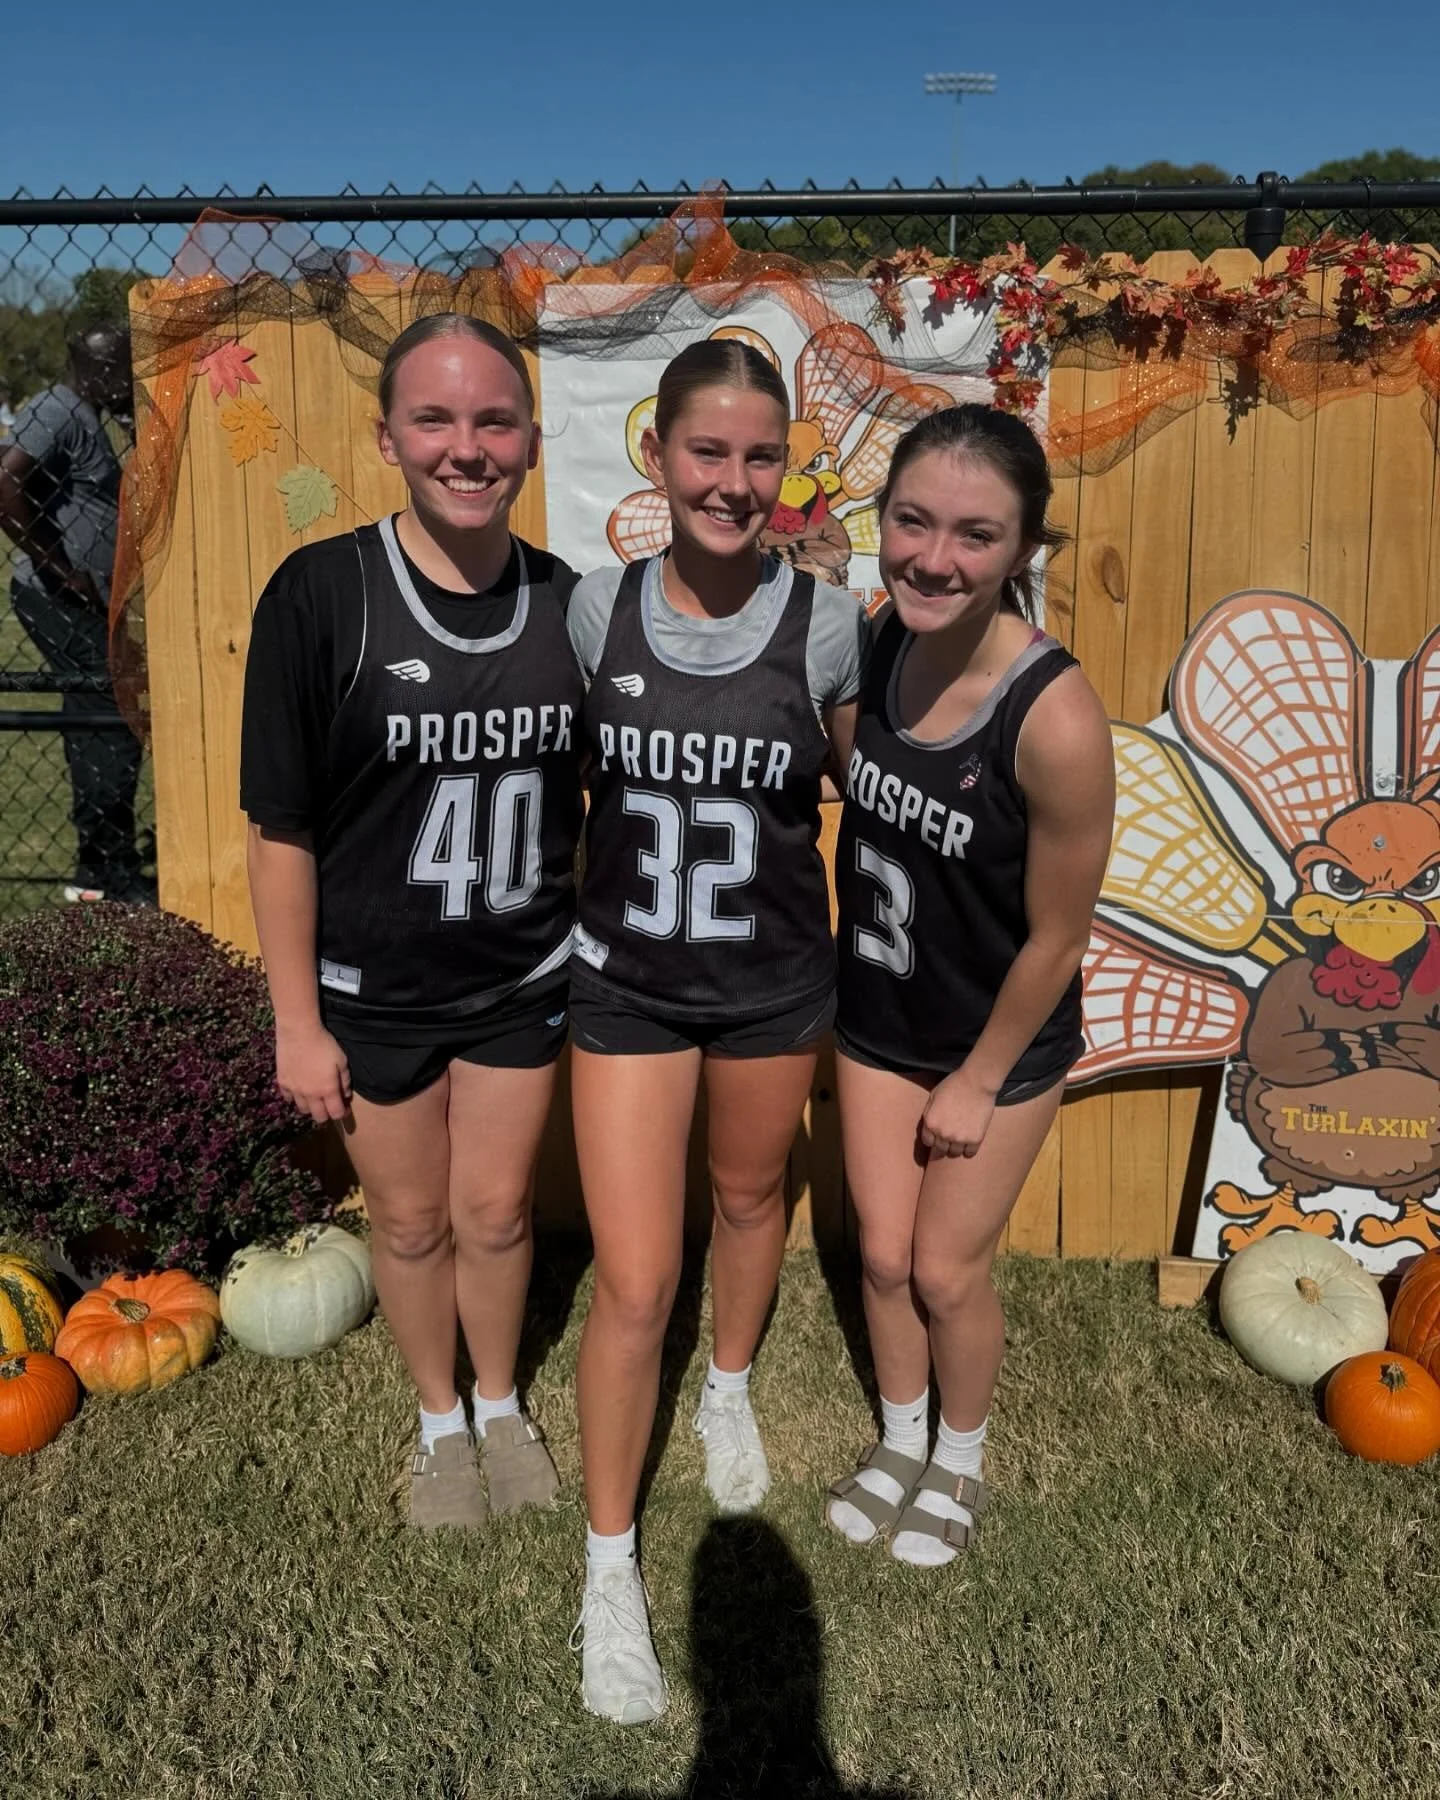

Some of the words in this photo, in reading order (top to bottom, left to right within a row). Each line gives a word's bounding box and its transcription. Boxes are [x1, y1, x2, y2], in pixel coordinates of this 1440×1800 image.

[386, 705, 573, 763] PROSPER
[600, 723, 792, 790] PROSPER
[407, 767, 543, 921] 40
[622, 786, 760, 943] 32
[846, 746, 974, 860] ROSPER
[853, 837, 916, 979] 3
